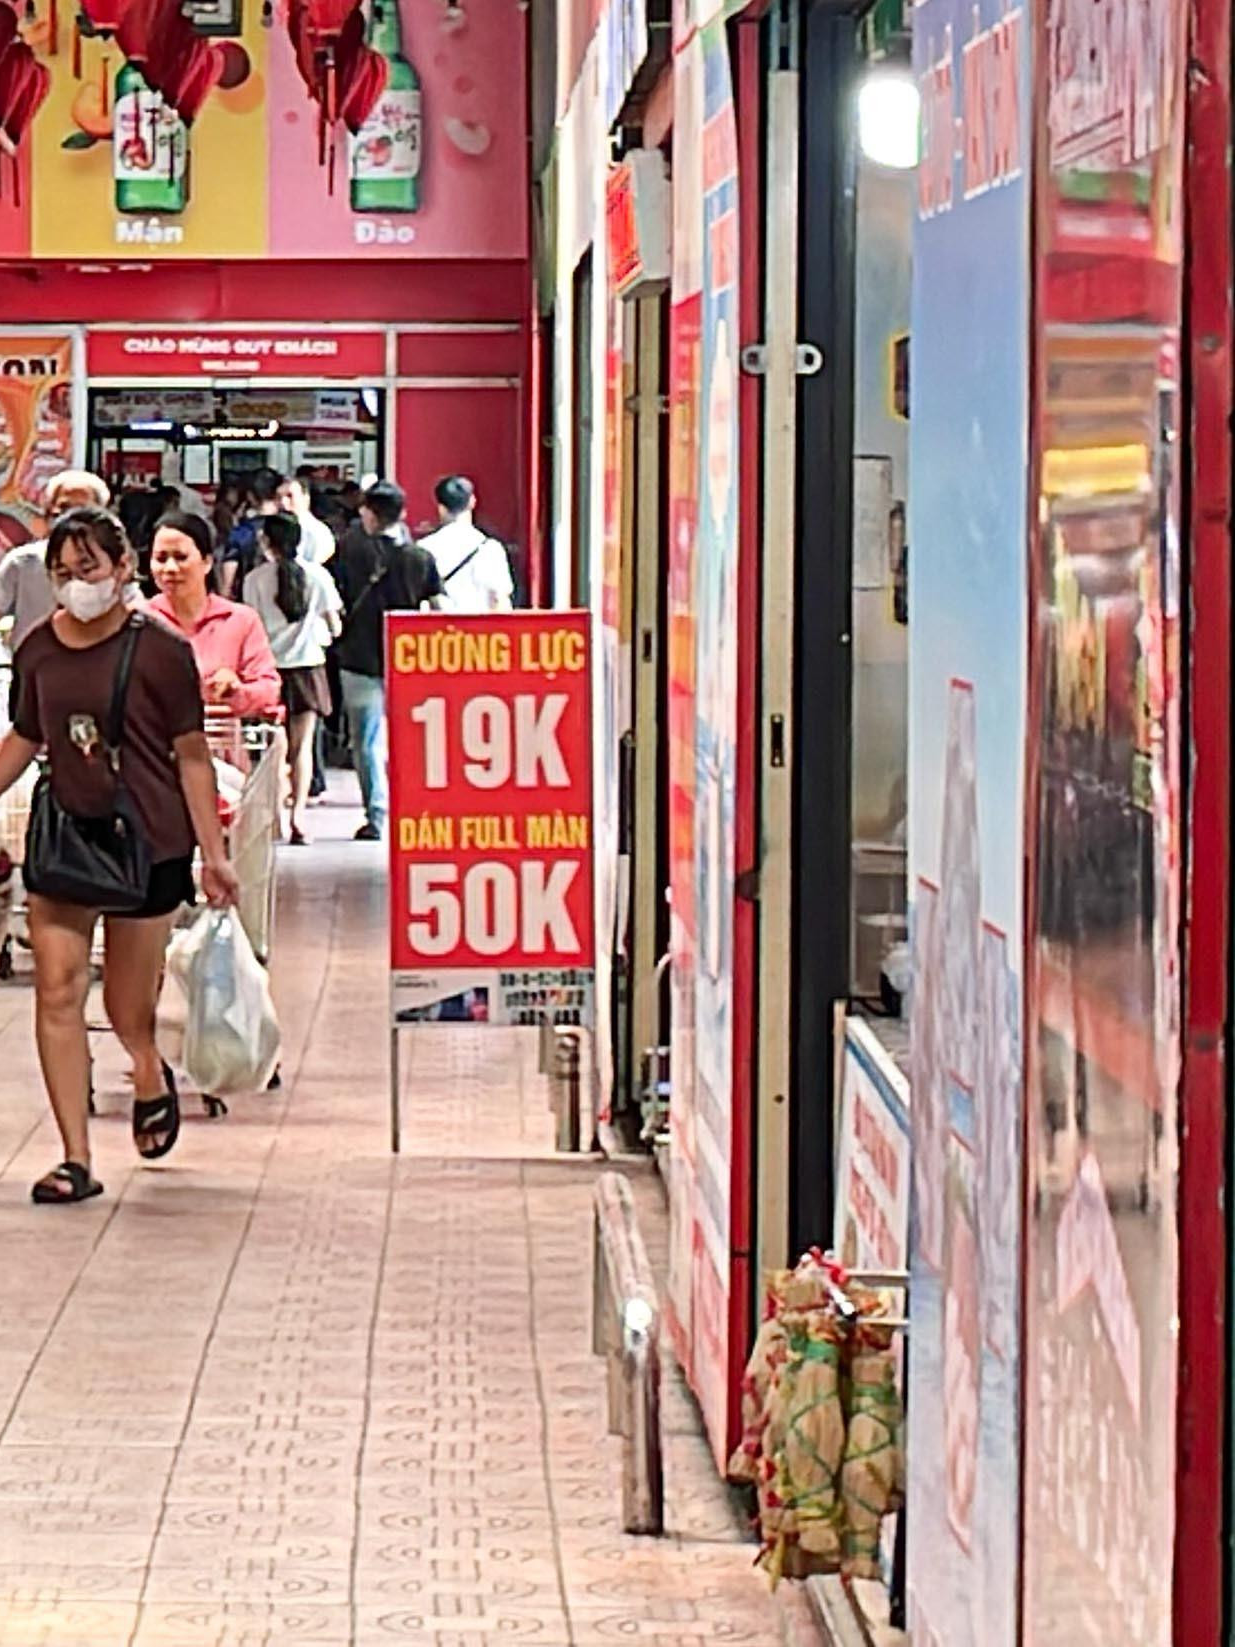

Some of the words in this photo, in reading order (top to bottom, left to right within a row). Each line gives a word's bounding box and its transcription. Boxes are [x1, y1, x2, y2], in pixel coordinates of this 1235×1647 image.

[115, 216, 183, 249] Mận
[394, 624, 511, 674] CƯỜNG
[520, 629, 586, 681] LỰC
[411, 693, 572, 790] 19K
[399, 810, 453, 851] DÁN
[460, 815, 522, 851] FULL
[526, 808, 589, 850] MÀN
[408, 860, 580, 957] 50K
